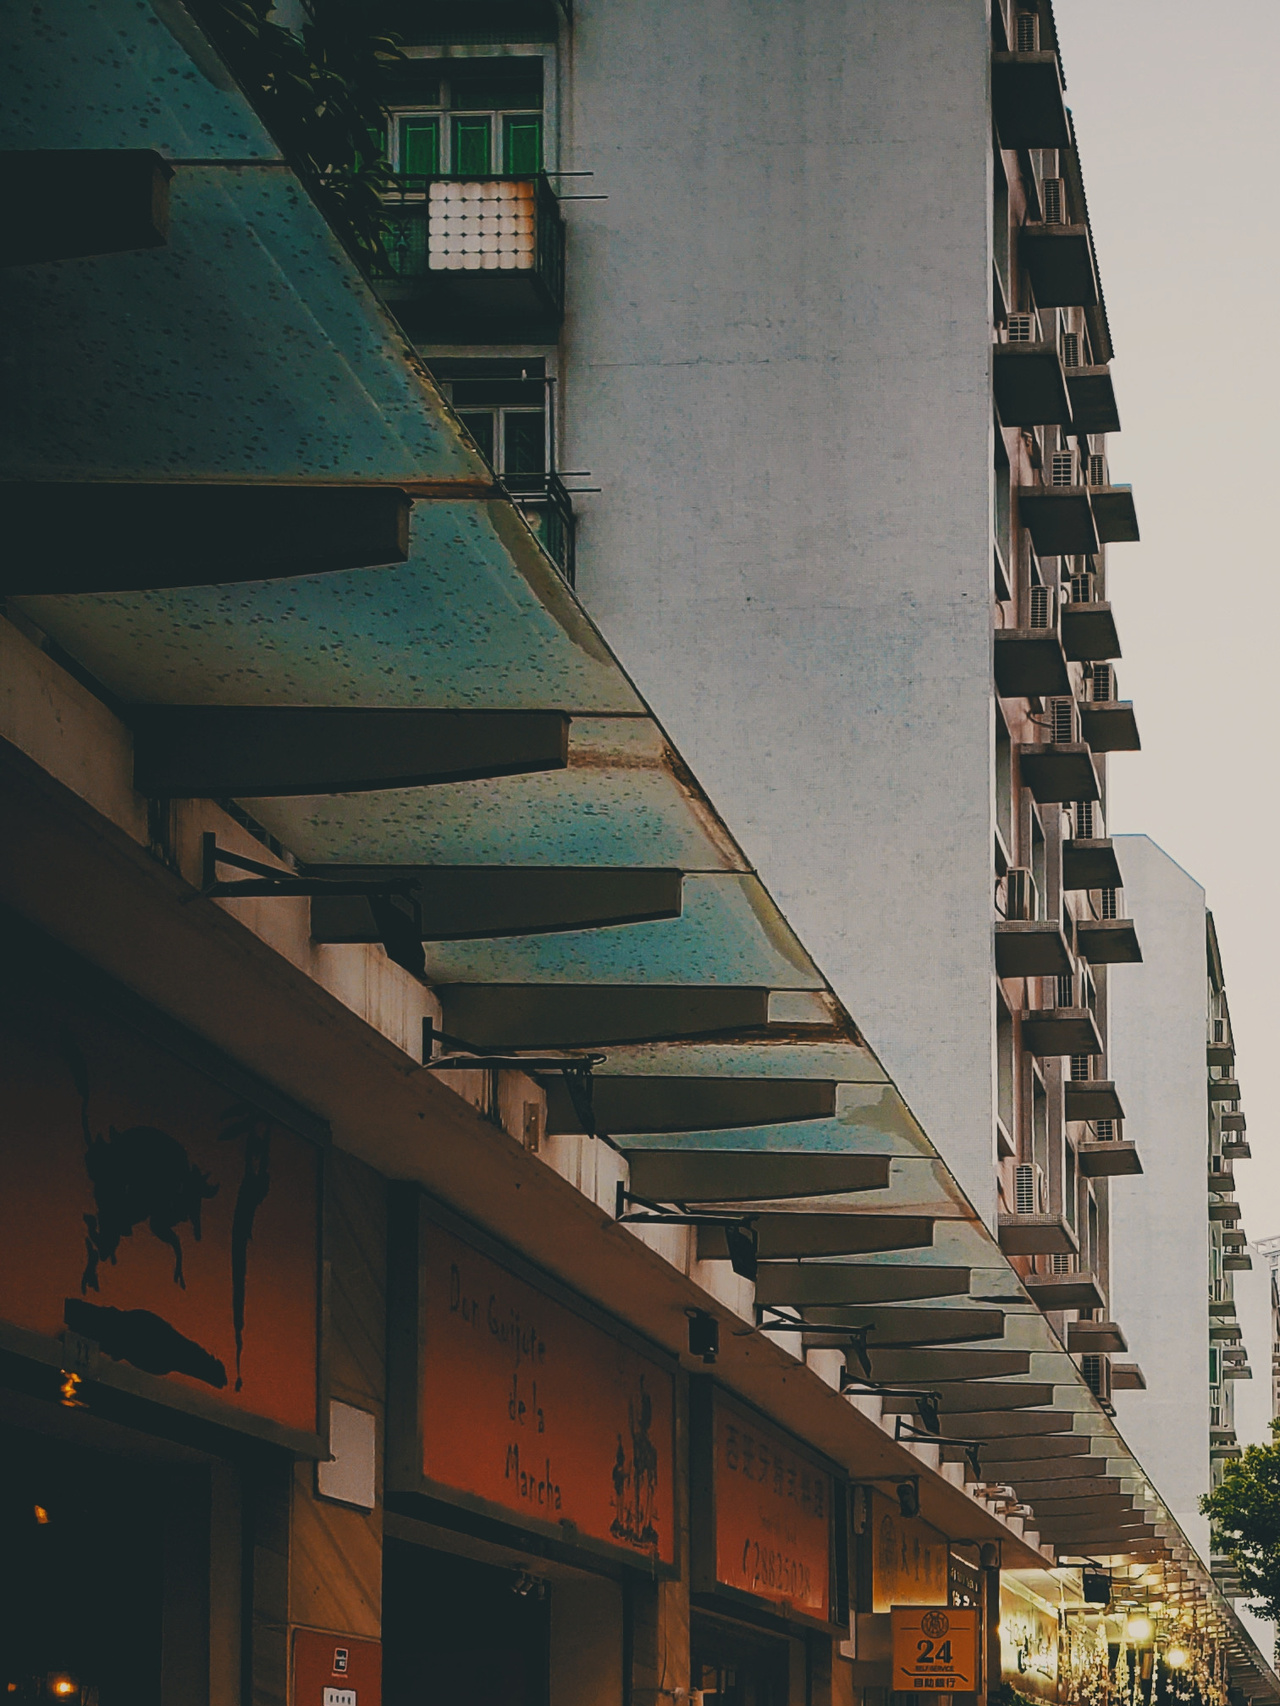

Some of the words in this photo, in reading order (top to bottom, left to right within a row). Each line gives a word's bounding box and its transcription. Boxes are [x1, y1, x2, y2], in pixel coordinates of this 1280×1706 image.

[507, 1373, 527, 1426] de
[532, 1379, 545, 1434] la
[916, 1639, 953, 1663] 24
[914, 1677, 956, 1688] 自助銀行
